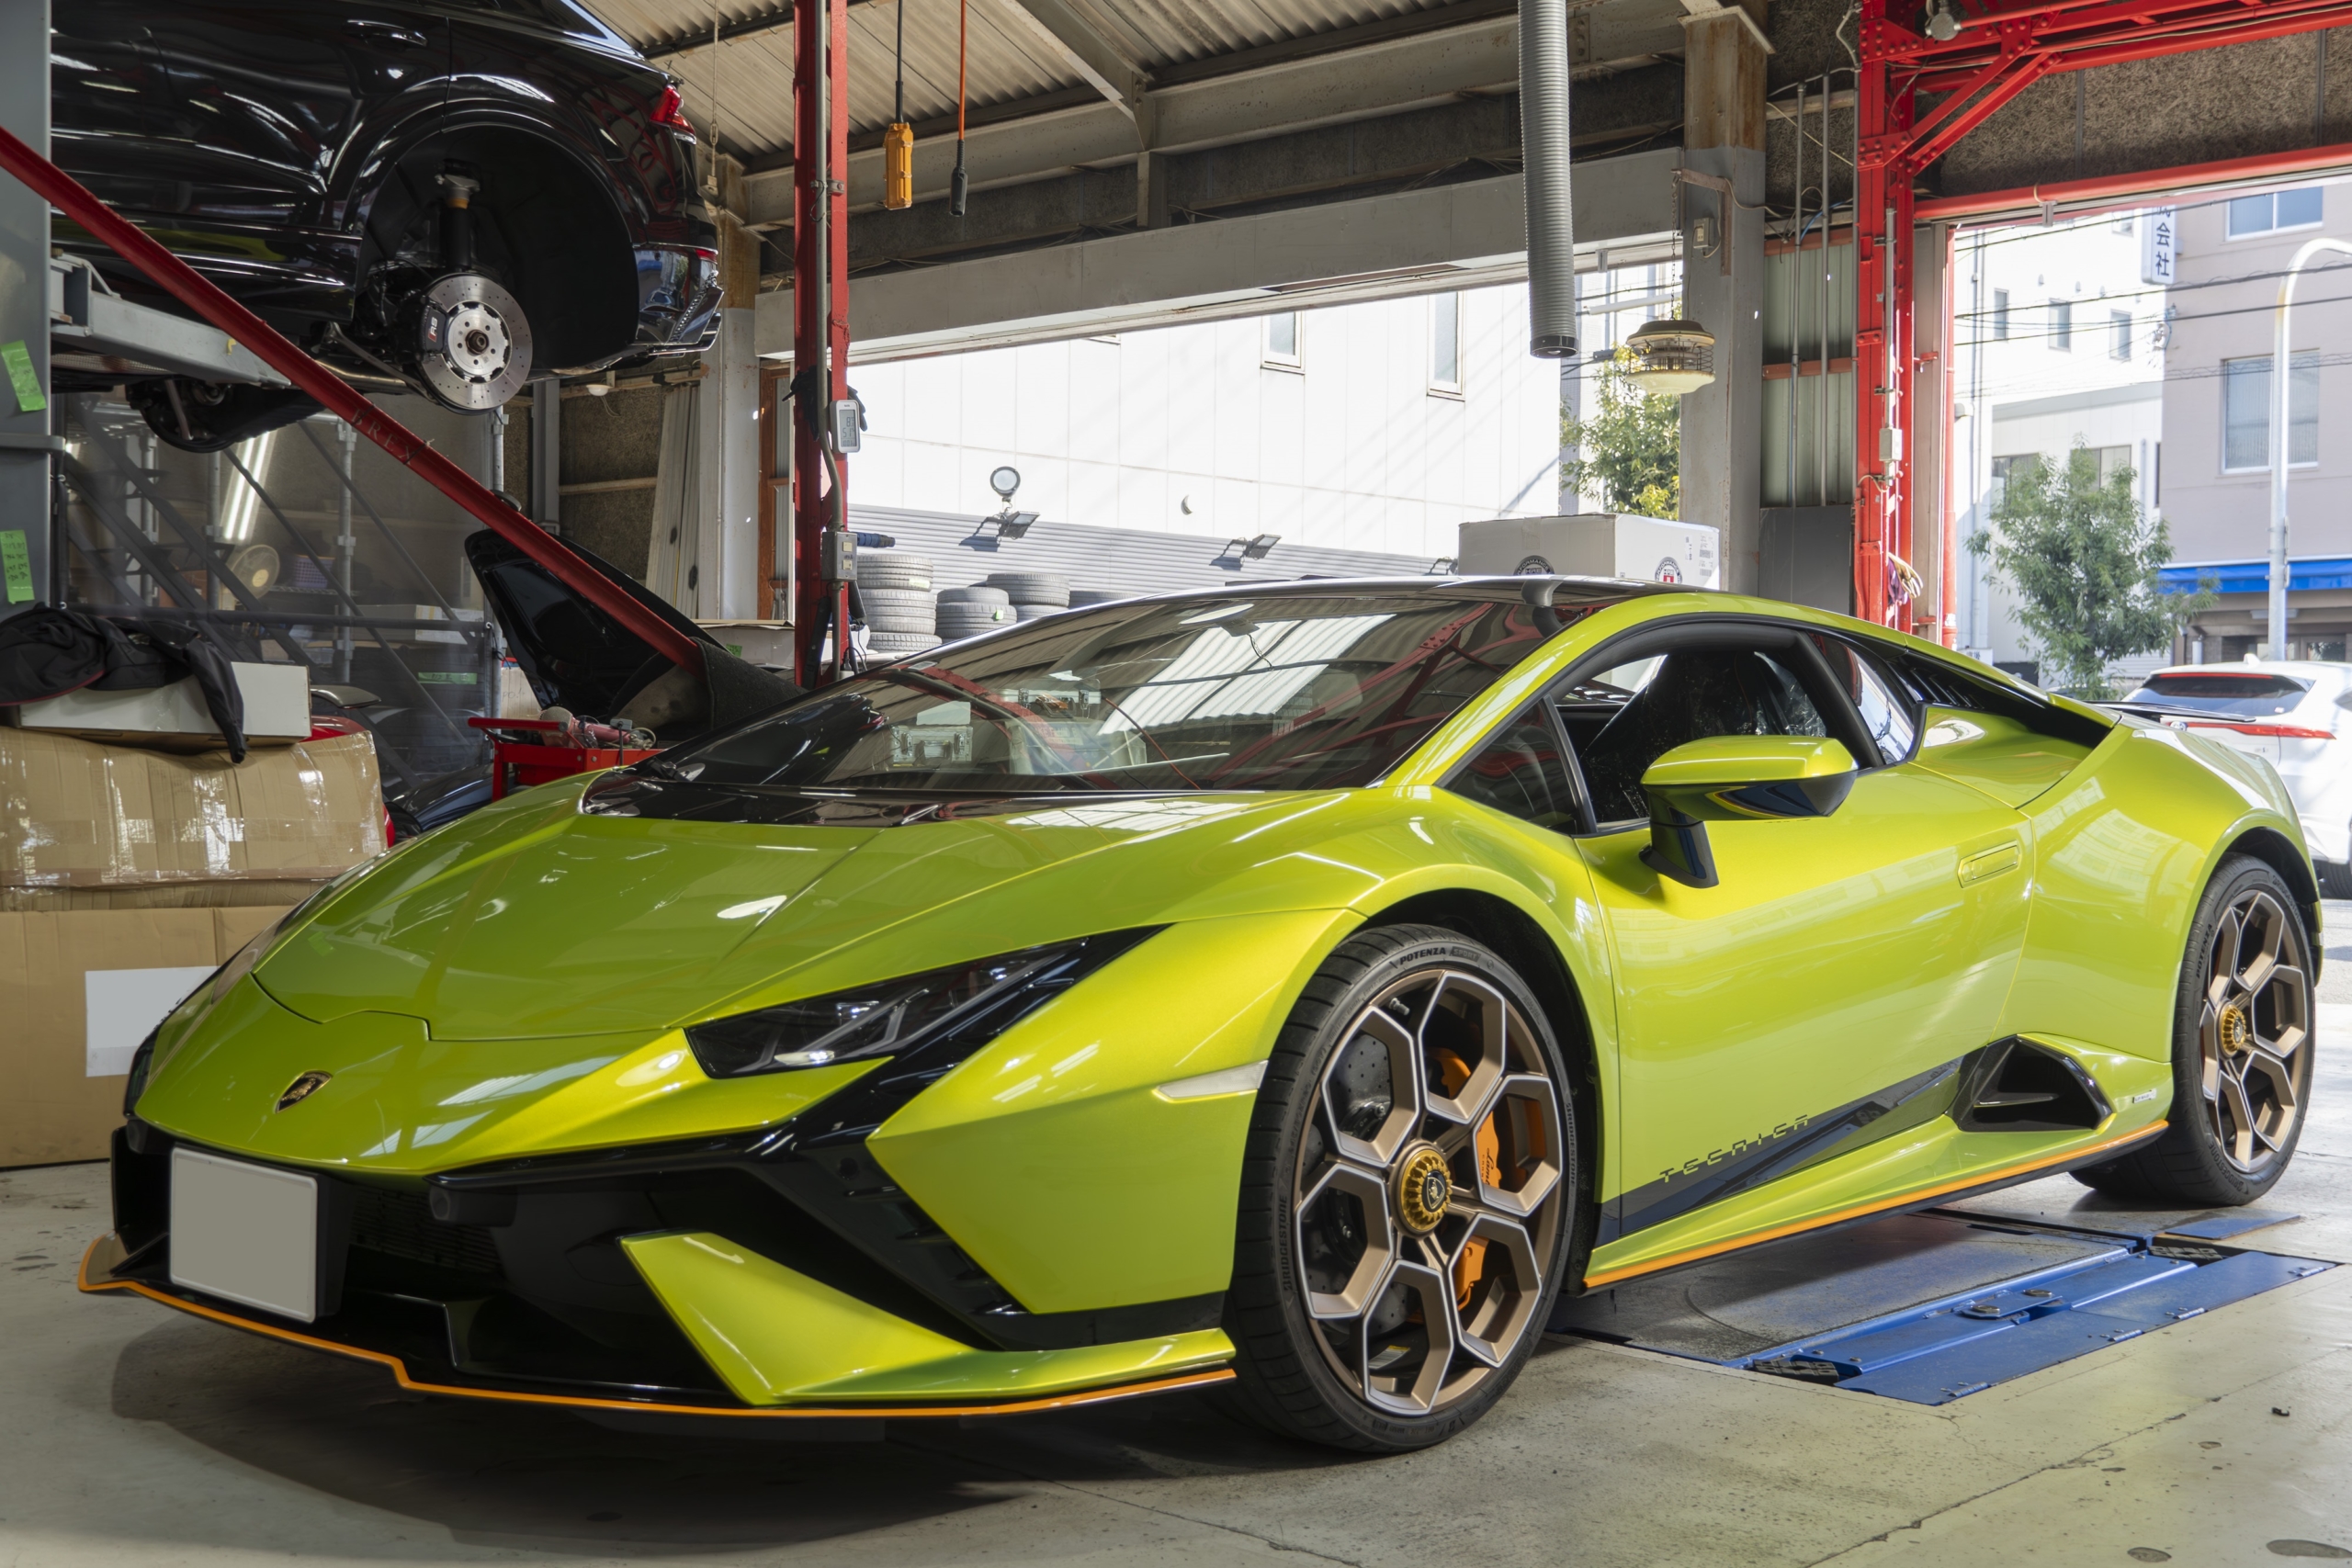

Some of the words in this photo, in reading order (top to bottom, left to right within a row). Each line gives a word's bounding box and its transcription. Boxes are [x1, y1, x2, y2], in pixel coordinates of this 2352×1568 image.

[1399, 947, 1447, 965] POTENZA
[1453, 948, 1477, 959] SPORT
[2196, 924, 2212, 979] POTENZA
[1566, 1102, 1576, 1185] BRIDGESTONE
[1659, 1114, 1808, 1183] TECNICA
[2208, 1142, 2245, 1192] BRIDGESTONE
[1278, 1195, 1293, 1292] BRIDGESTONE
